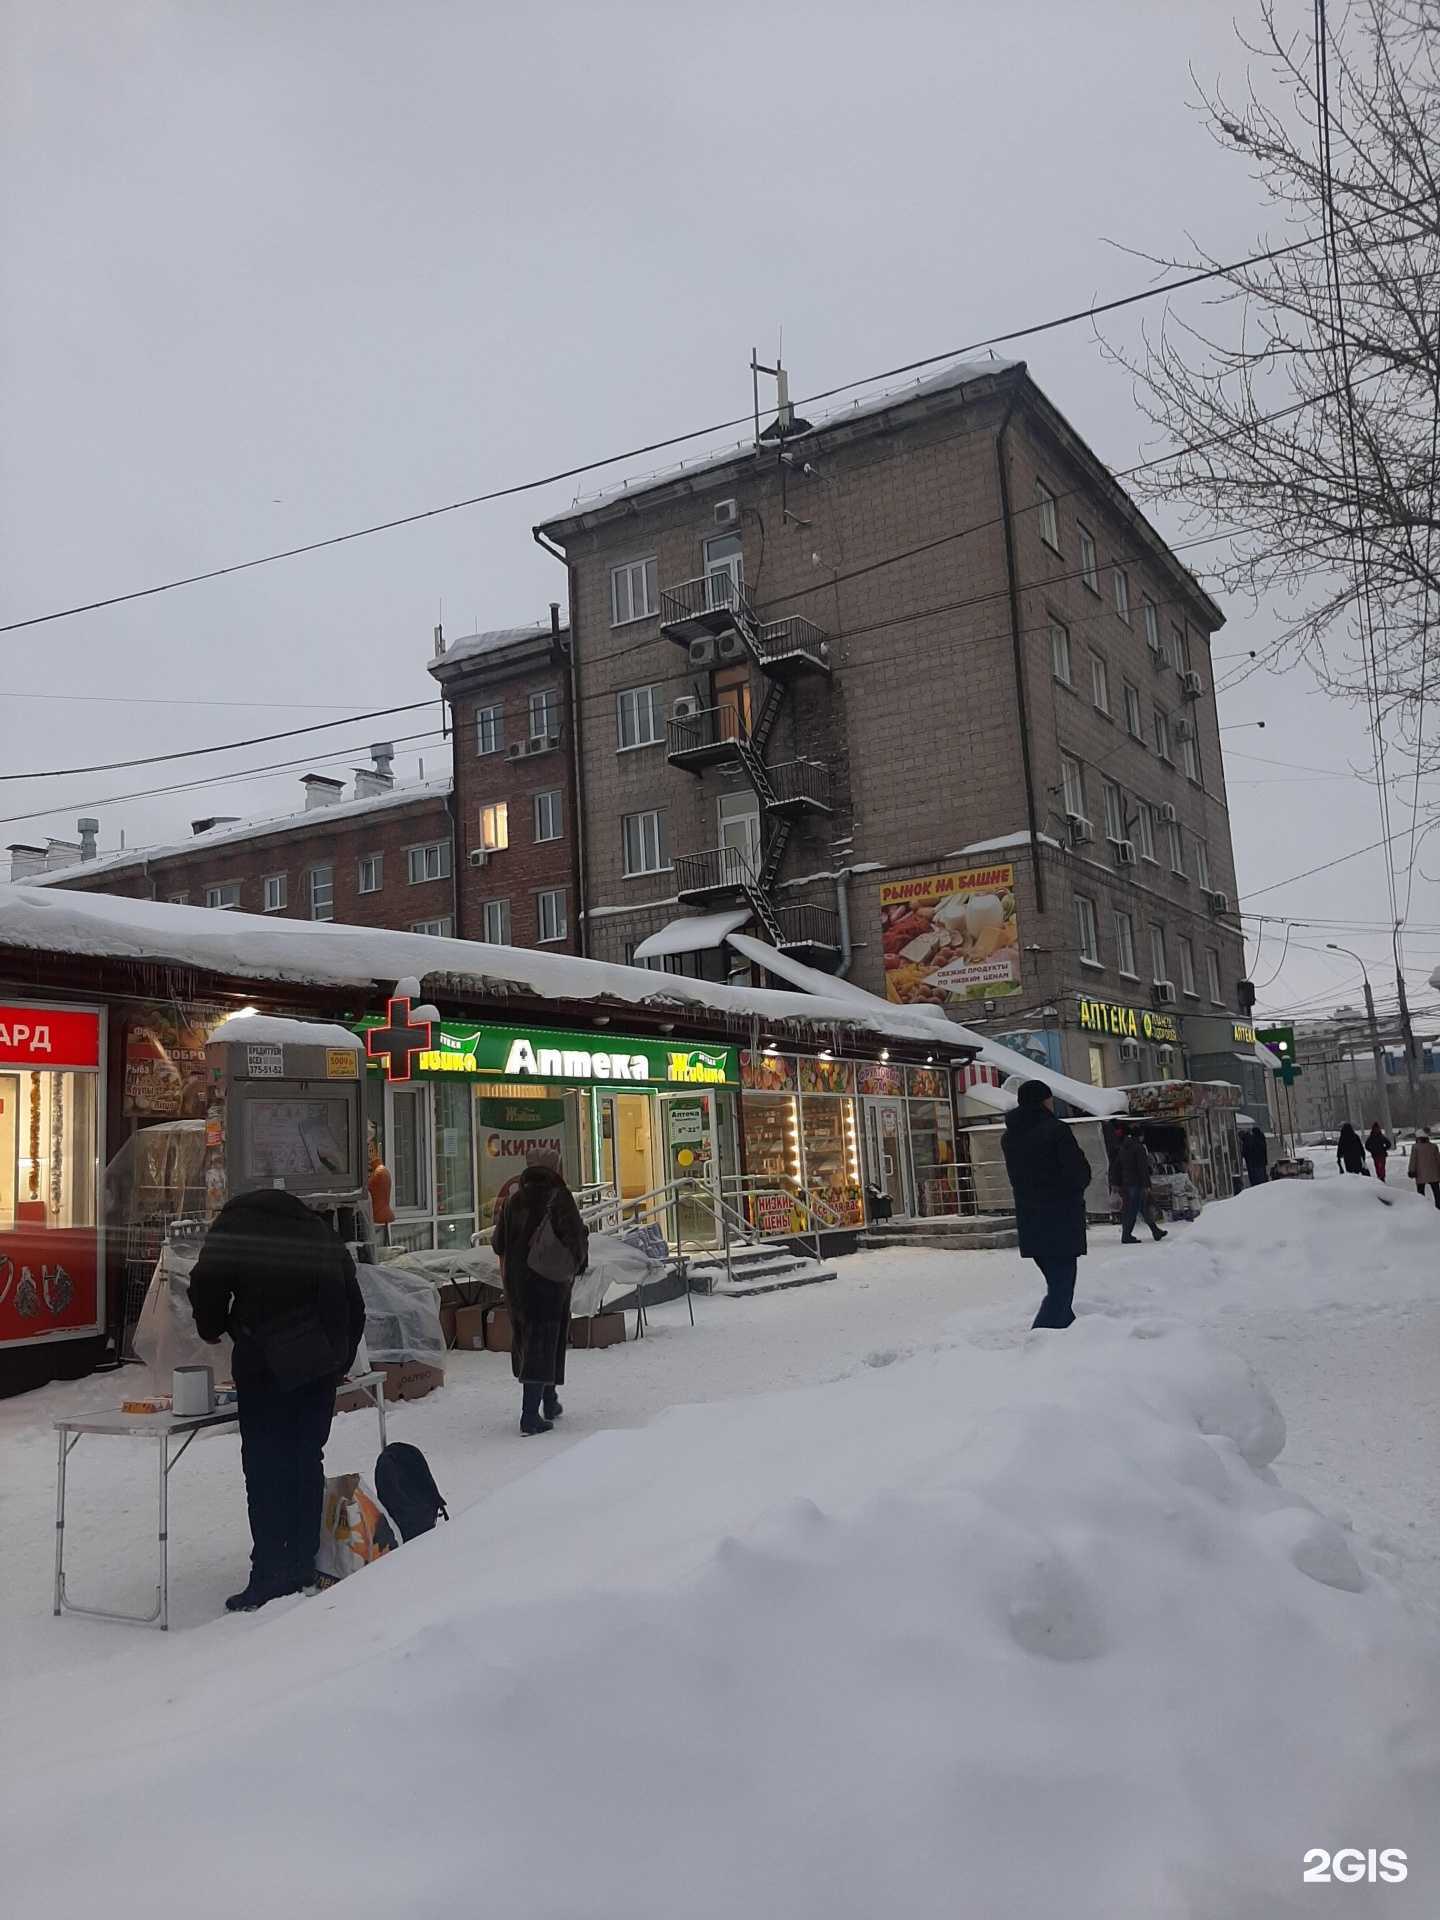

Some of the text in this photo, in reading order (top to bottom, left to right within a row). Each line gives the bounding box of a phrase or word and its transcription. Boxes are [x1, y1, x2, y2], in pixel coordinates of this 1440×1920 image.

[883, 868, 1011, 900] РЫНОК НА БАШНЕ
[937, 963, 1008, 978] СВЕЖИЕ ПРОДУКТЫ
[951, 975, 980, 985] НИЗКИМ
[983, 972, 1009, 981] ЦЕНАМ
[1080, 1000, 1138, 1037] АПТЕКА
[1234, 1025, 1257, 1043] АПТЕКА
[505, 1039, 649, 1080] Аптека
[668, 1053, 726, 1084] Живика
[759, 1194, 794, 1212] НИЗКИЕ
[764, 1215, 791, 1231] ЦЕНЫ
